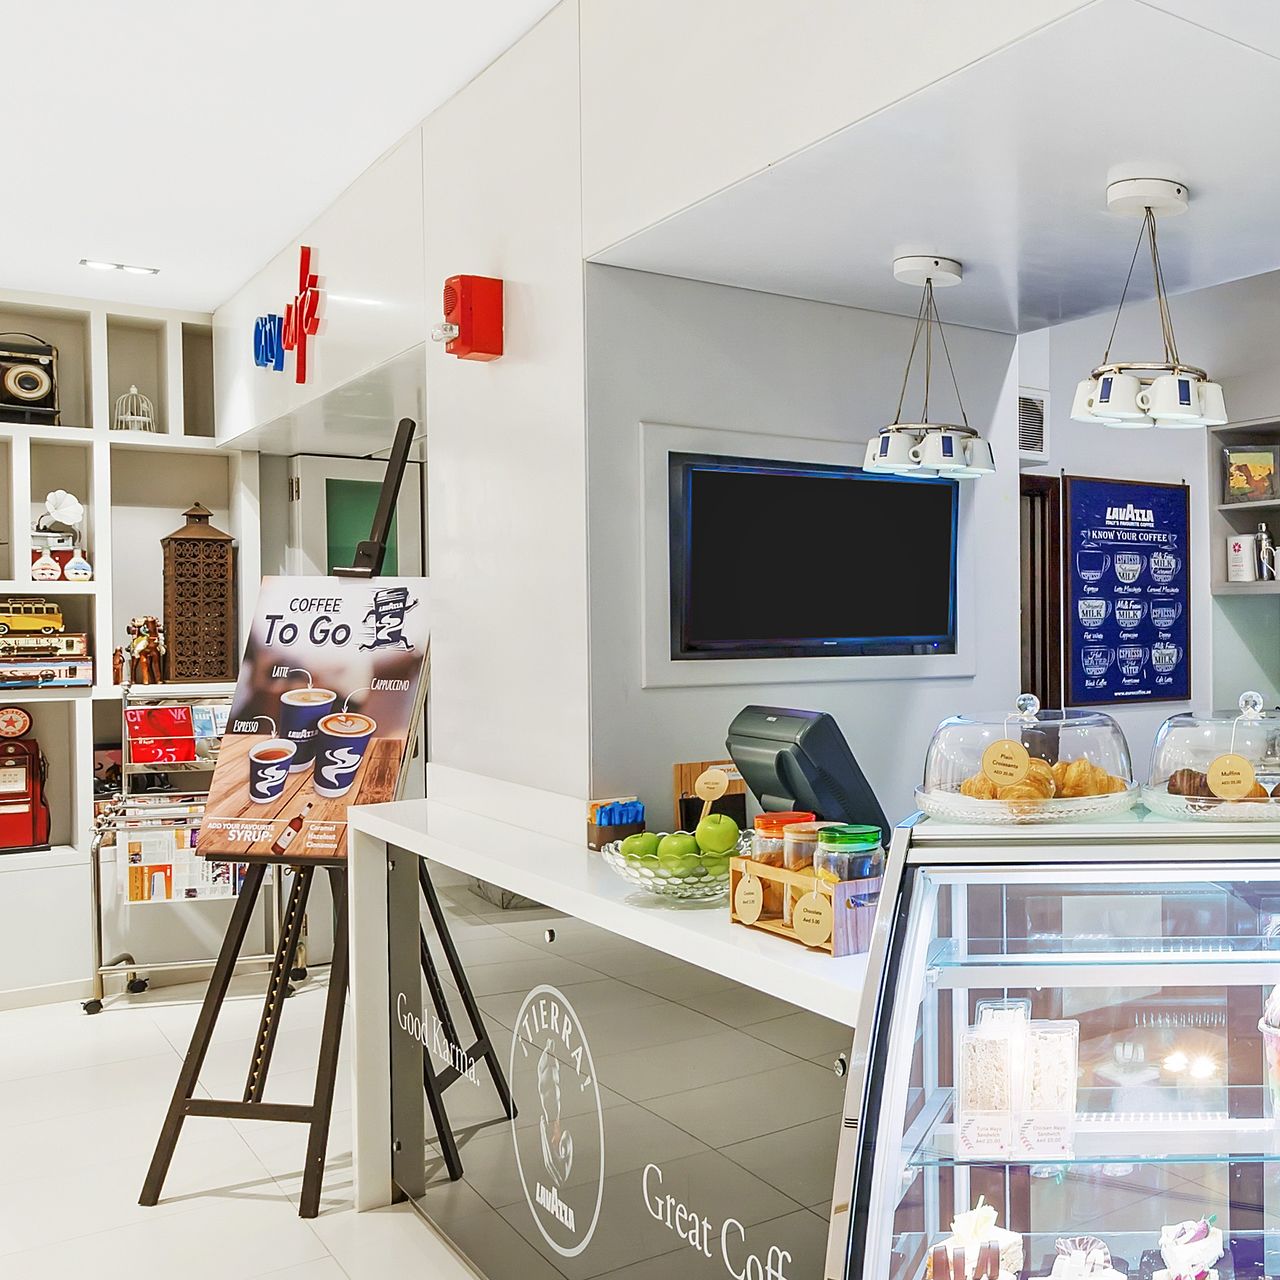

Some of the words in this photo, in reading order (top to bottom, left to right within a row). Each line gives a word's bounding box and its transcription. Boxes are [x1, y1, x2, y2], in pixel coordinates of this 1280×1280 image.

[1106, 504, 1154, 522] LAVAZZA
[1092, 530, 1116, 539] KNOW
[1116, 531, 1137, 541] YOUR
[1139, 533, 1168, 542] COFFEE
[1153, 559, 1173, 567] MILK
[1118, 572, 1138, 581] MILK
[290, 598, 342, 612] COFFEE
[1118, 611, 1138, 619] MILK
[265, 615, 299, 645] To
[309, 616, 351, 645] Go
[222, 823, 241, 831] YOUR
[309, 824, 336, 832] Caramel
[227, 829, 273, 843] SYRUP:
[397, 992, 428, 1047] Good
[432, 1015, 480, 1087] Karma.
[536, 1182, 575, 1232] LAVAZZA
[643, 1163, 712, 1258] Great
